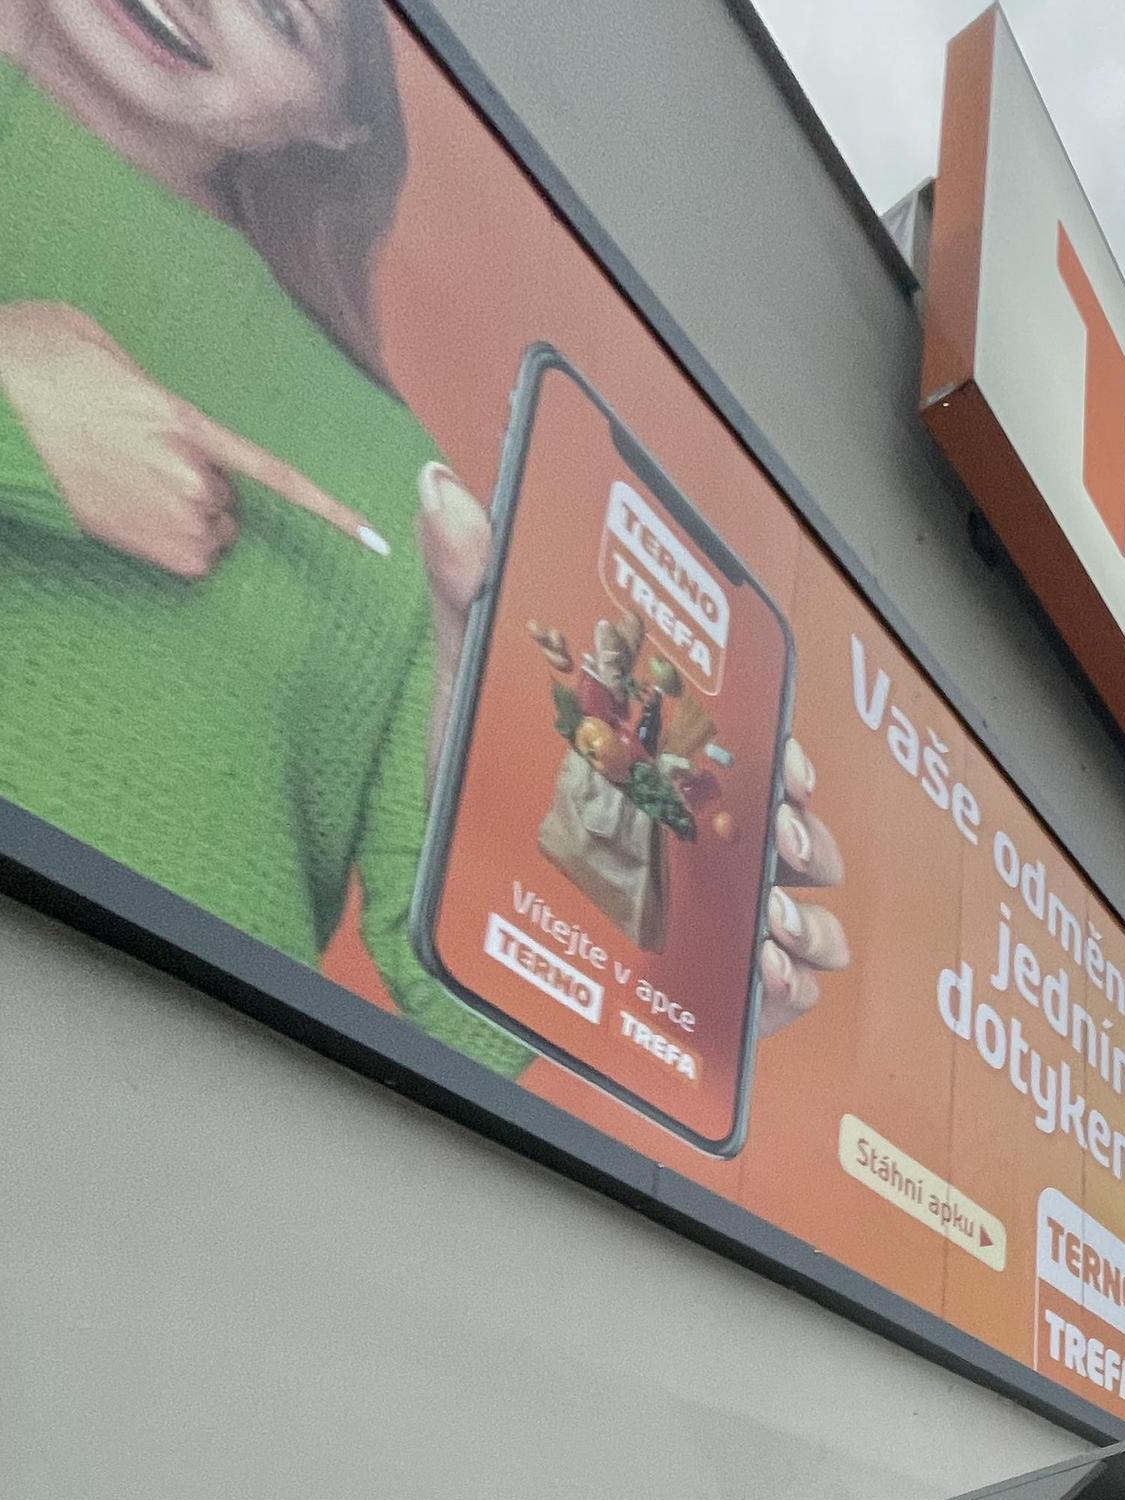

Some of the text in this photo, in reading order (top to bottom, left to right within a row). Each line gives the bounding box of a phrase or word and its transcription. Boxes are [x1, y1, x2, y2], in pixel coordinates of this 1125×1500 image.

[612, 552, 712, 677] TREFA
[621, 502, 720, 624] TERNO
[851, 633, 981, 846] Vaše
[498, 927, 697, 1081] TERNO TREFA
[513, 880, 696, 1032] Vítejte v apce
[928, 1194, 975, 1238] apku
